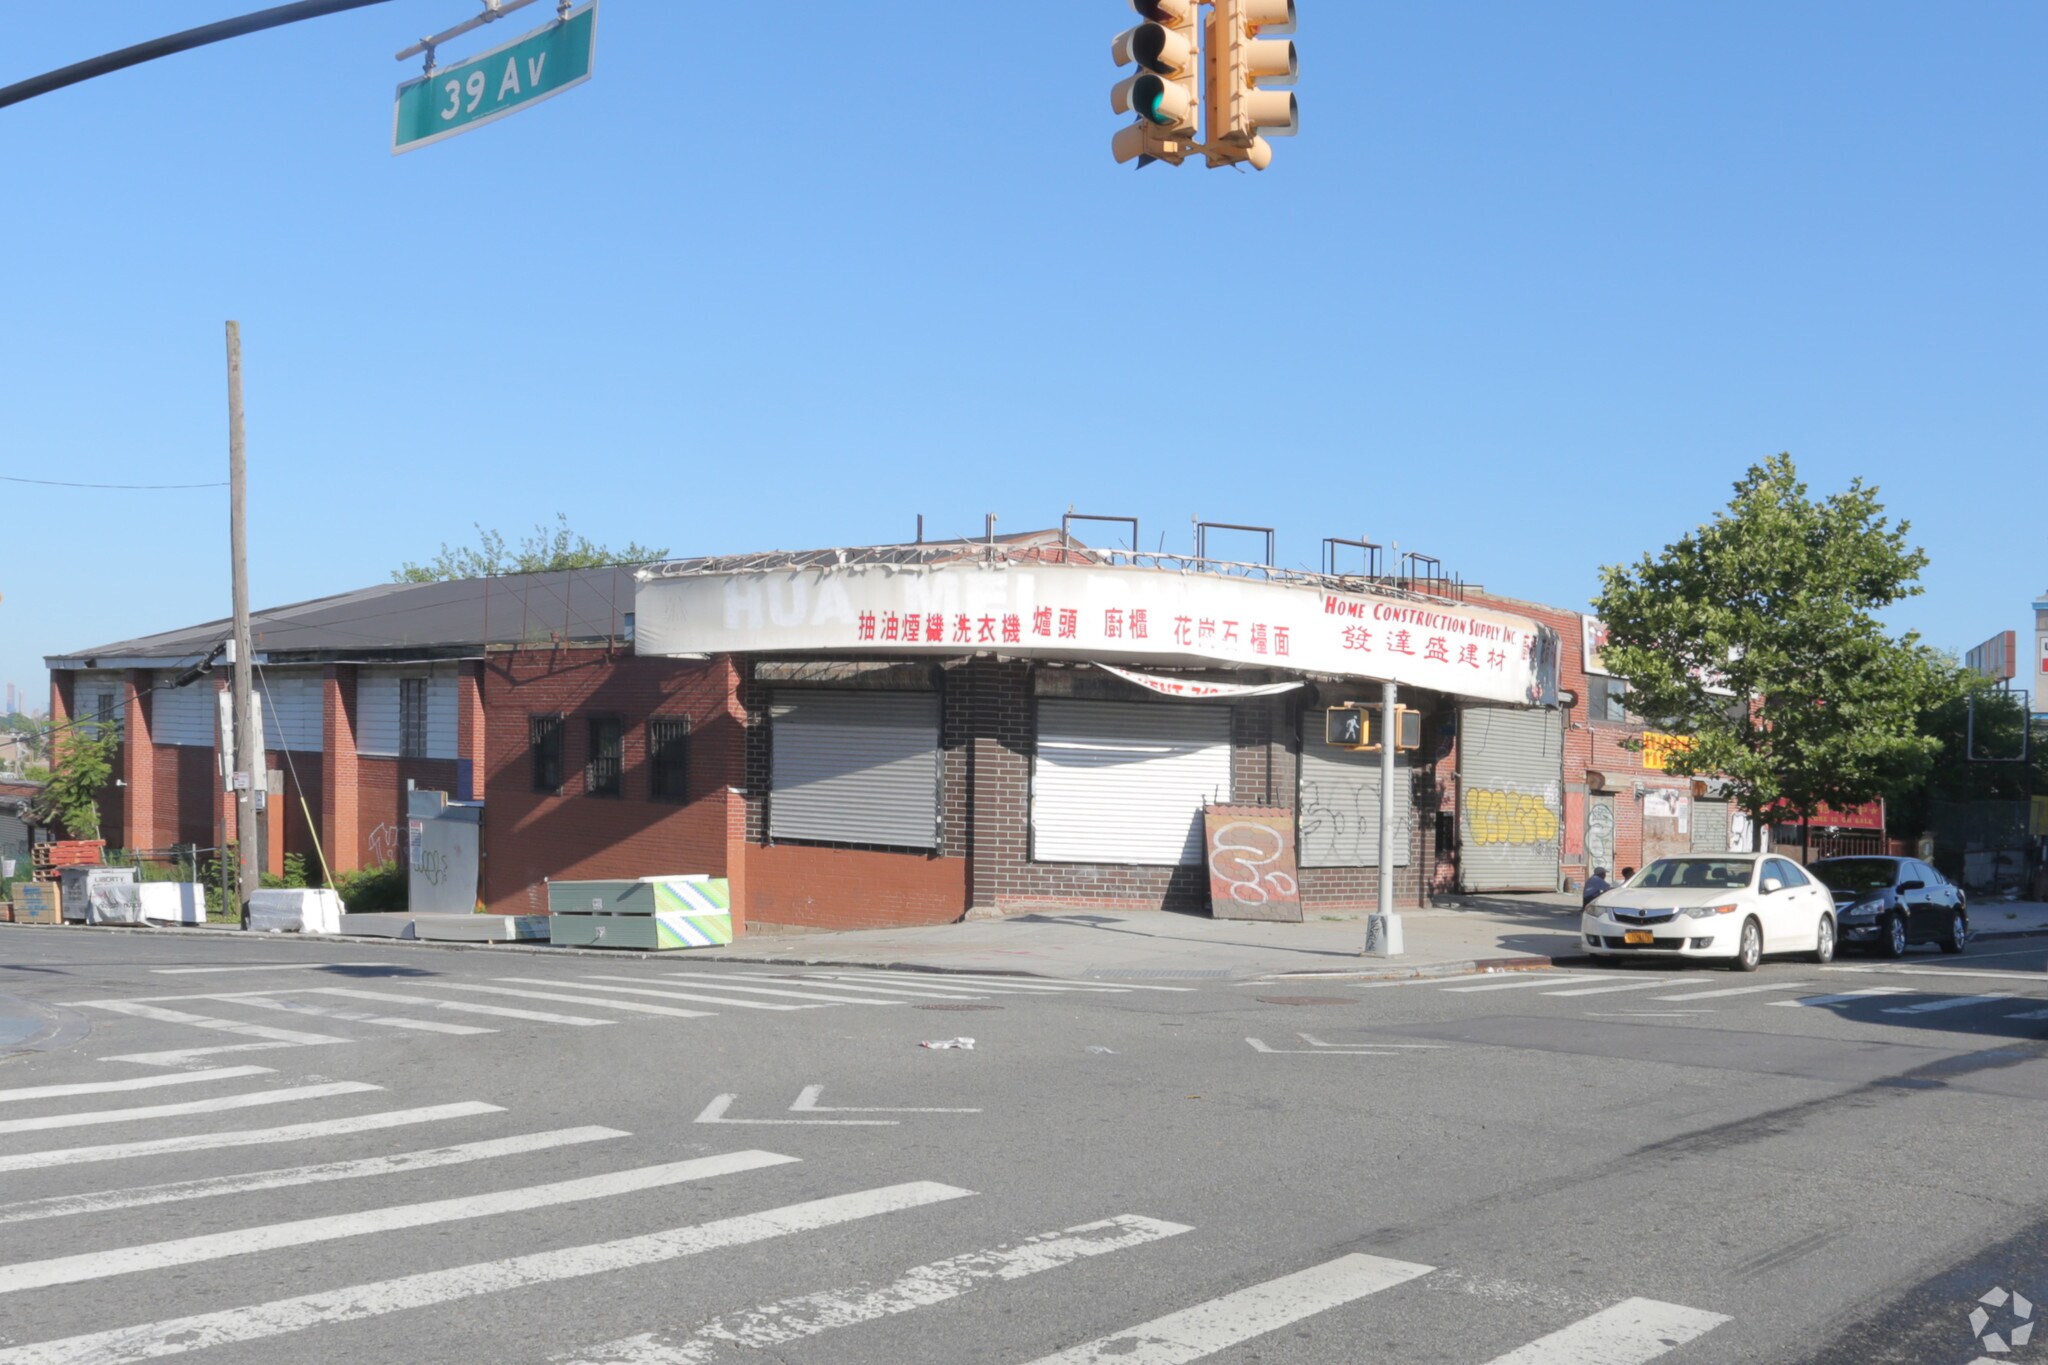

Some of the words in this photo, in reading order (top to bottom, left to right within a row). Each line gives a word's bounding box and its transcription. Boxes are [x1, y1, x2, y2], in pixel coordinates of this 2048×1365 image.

[441, 70, 485, 120] 39
[497, 52, 546, 101] AV
[725, 577, 857, 629] HUA
[1325, 595, 1366, 619] HOME
[1373, 603, 1467, 635] CONSTRUCTION
[1468, 619, 1501, 642] SUPPLY
